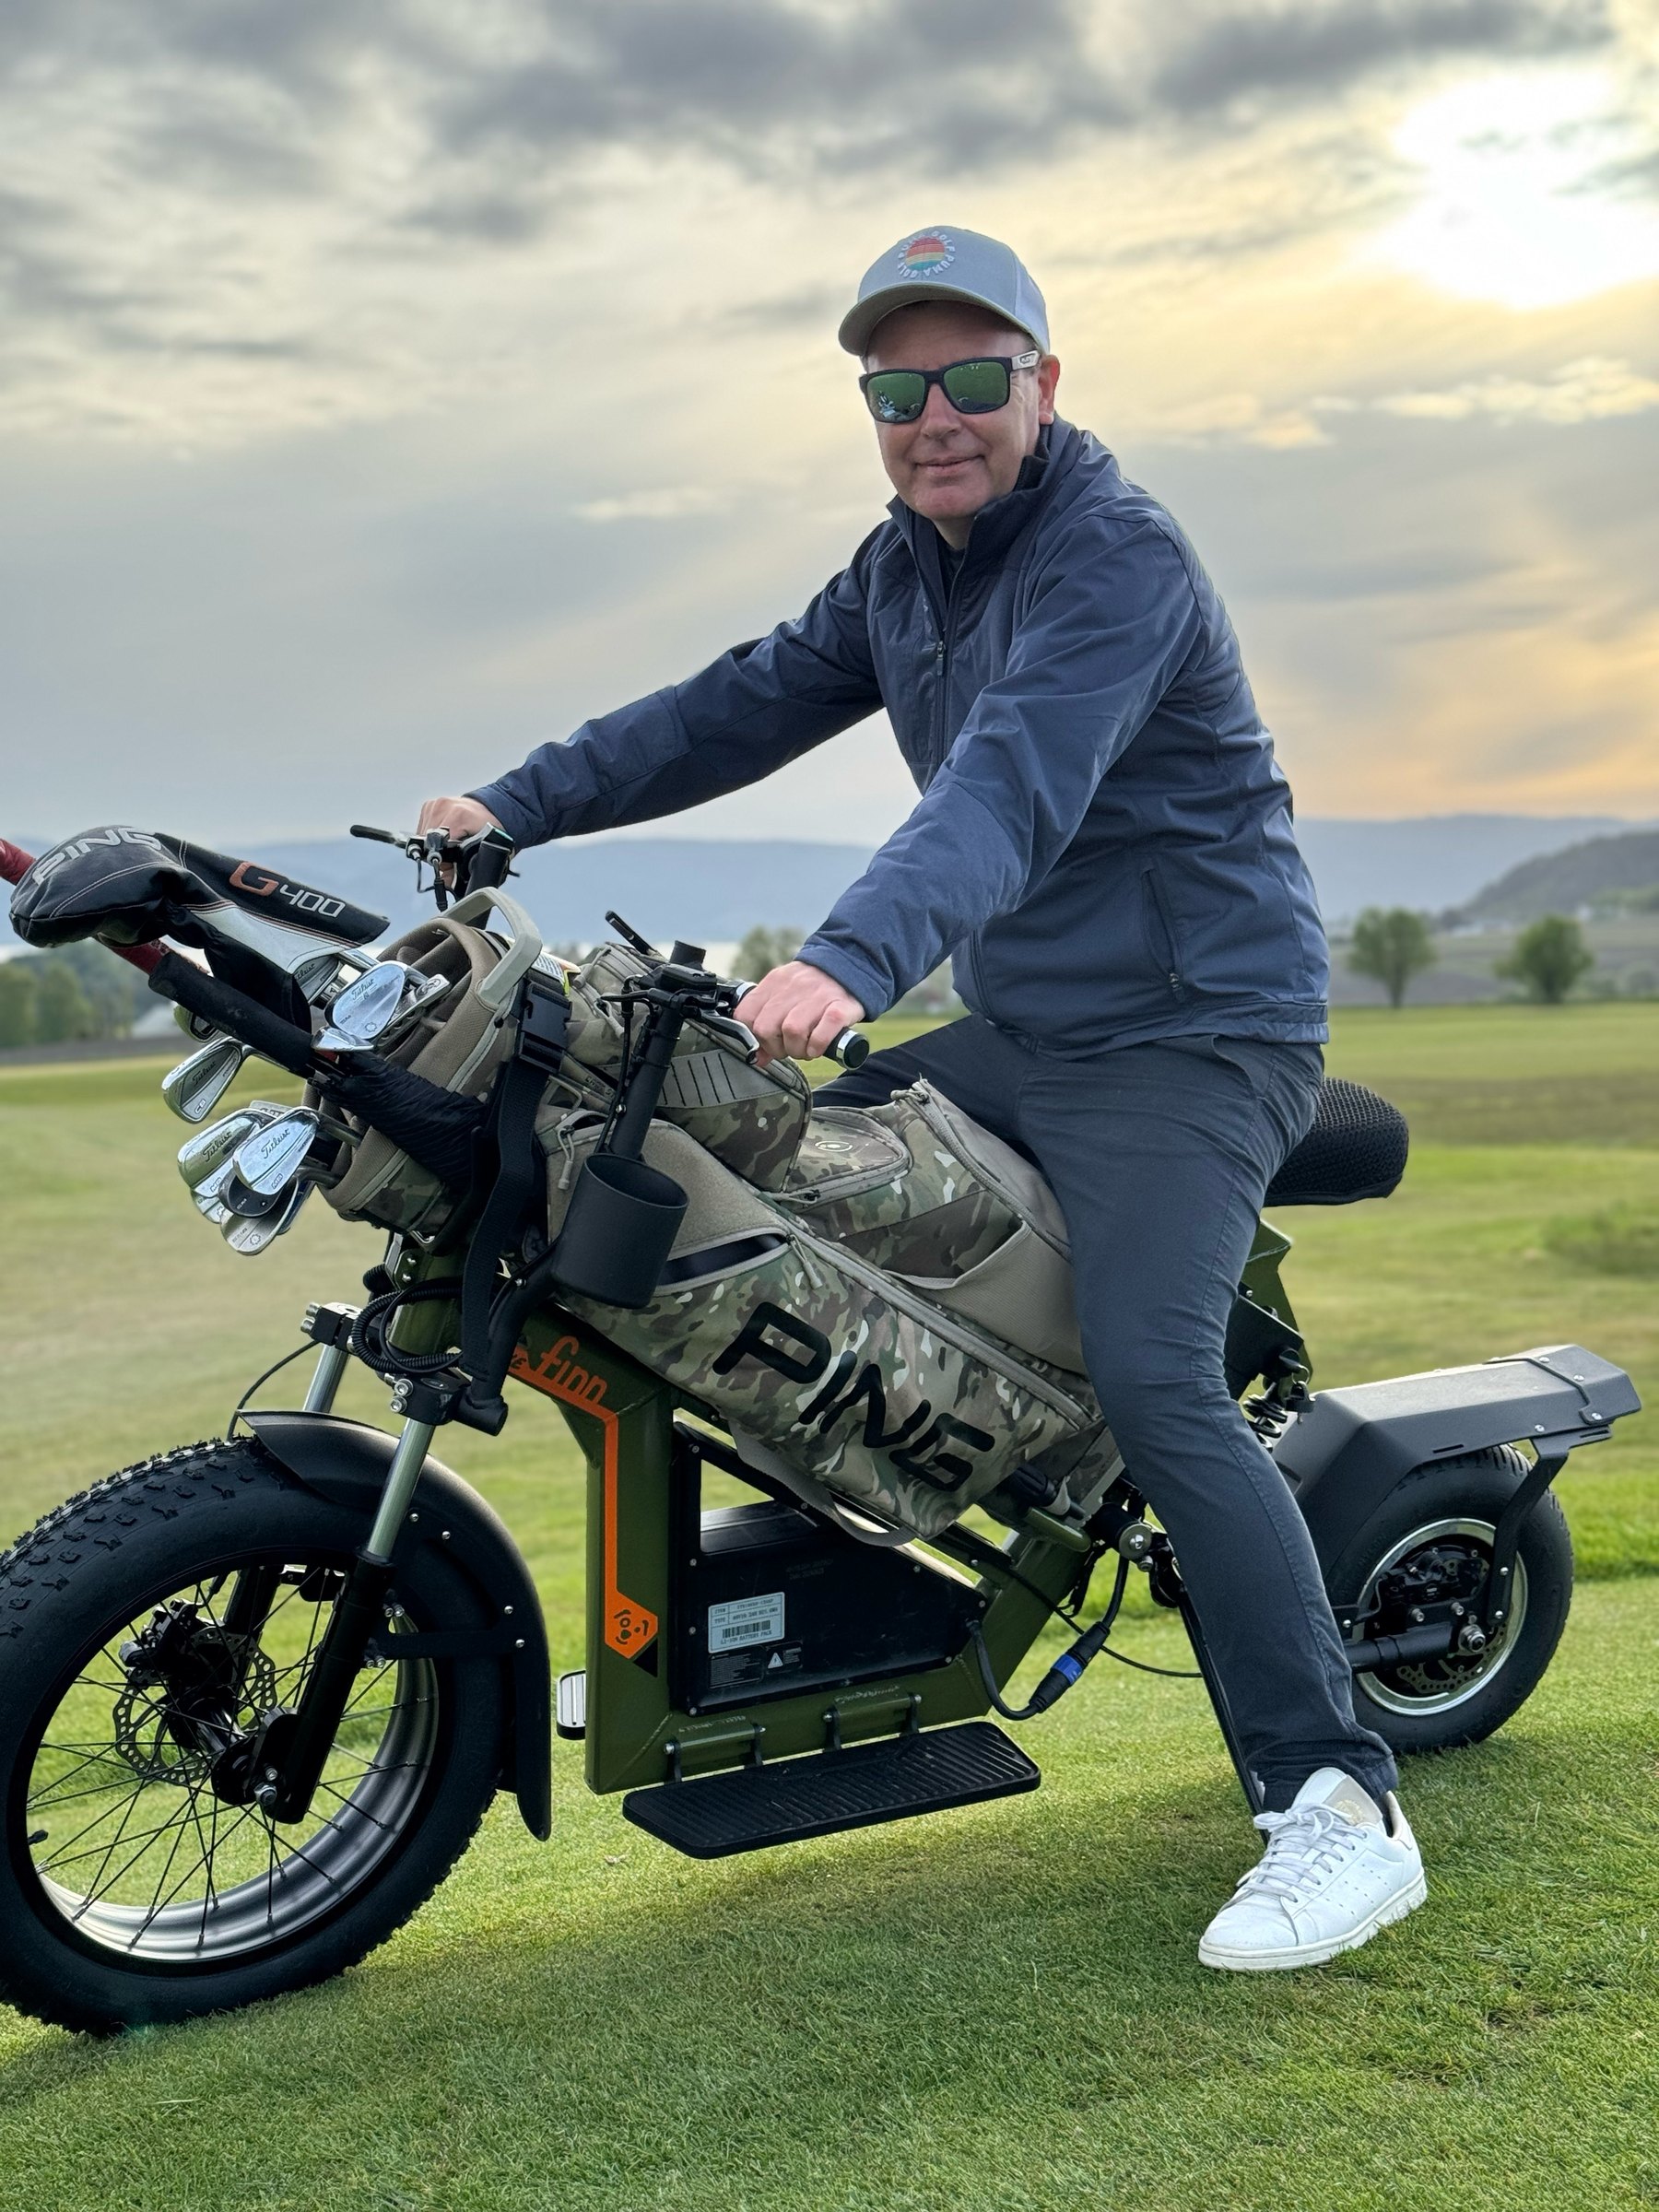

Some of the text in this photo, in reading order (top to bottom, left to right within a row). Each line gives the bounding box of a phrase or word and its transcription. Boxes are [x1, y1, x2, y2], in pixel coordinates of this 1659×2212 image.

[931, 230, 956, 253] GOLF
[898, 253, 955, 278] PUMA GOLF
[32, 827, 163, 886] PING
[203, 1130, 232, 1162] Titleist
[261, 1128, 290, 1159] Titleist
[535, 1335, 607, 1406] finn
[711, 1300, 995, 1492] PING
